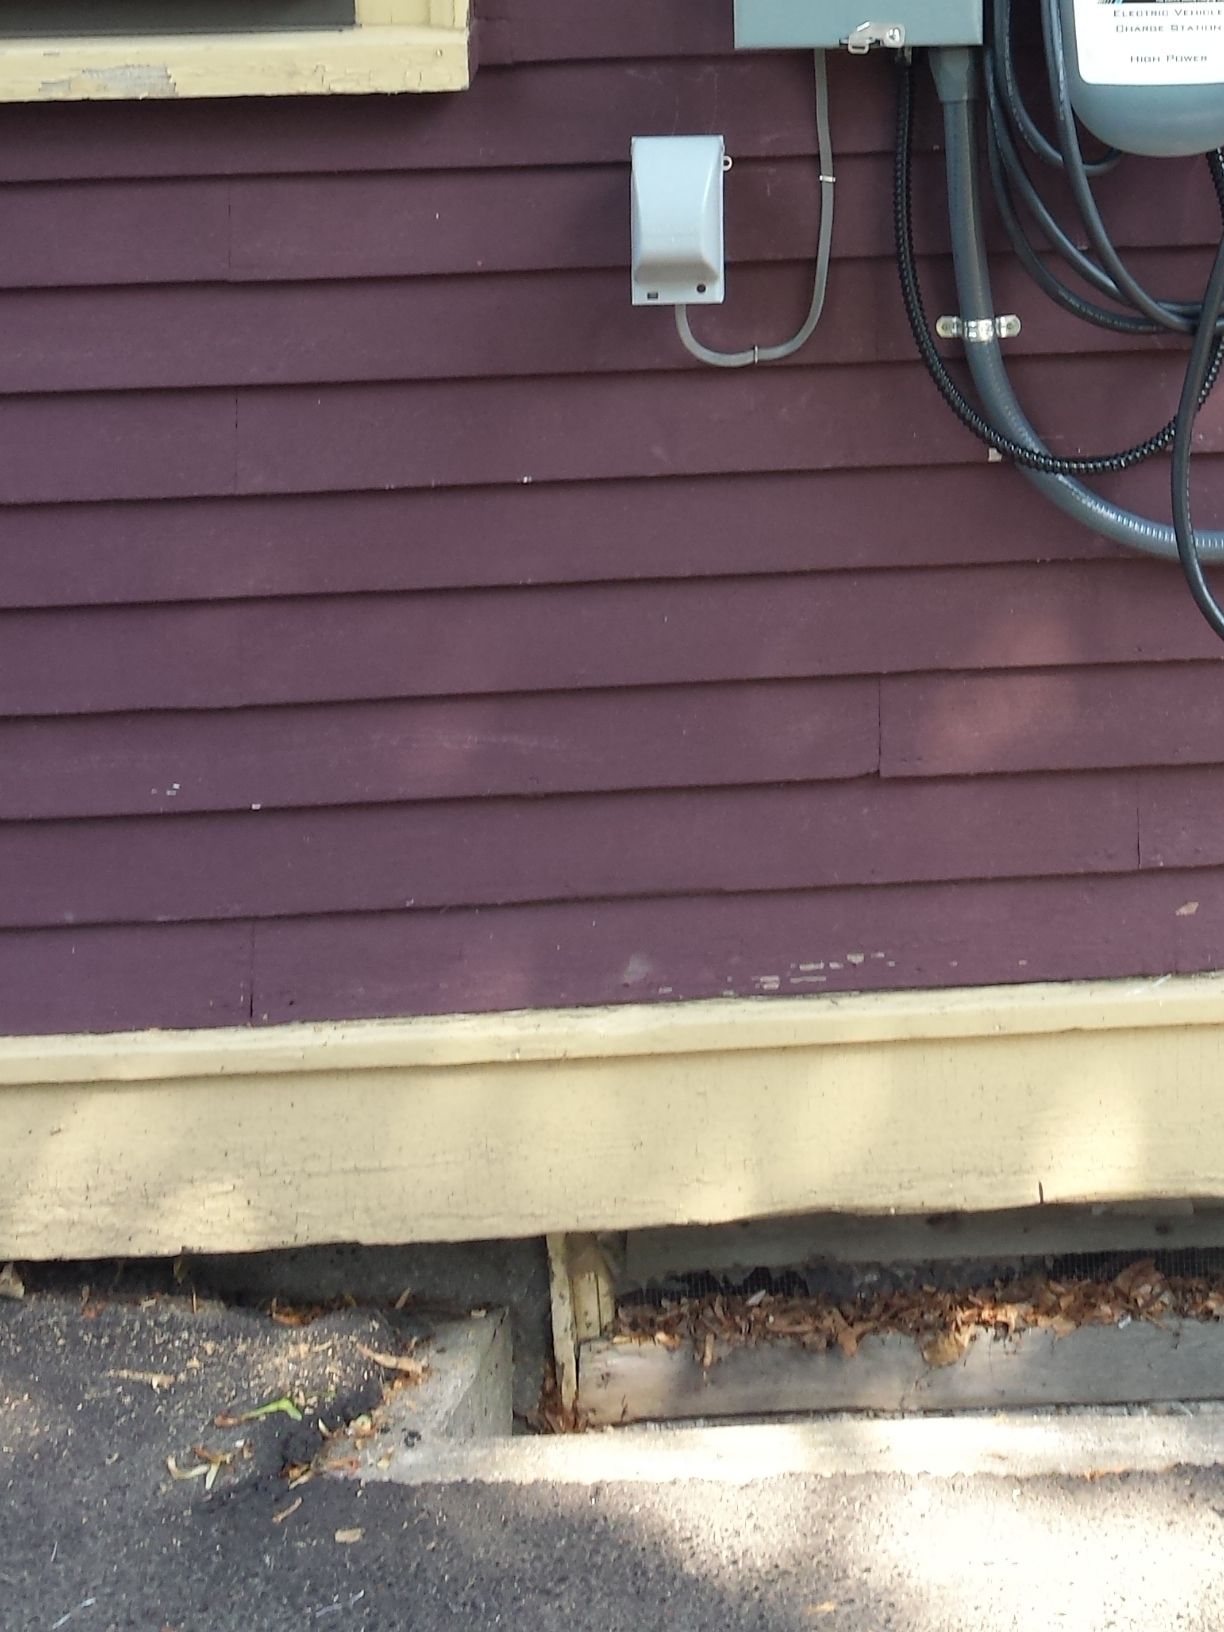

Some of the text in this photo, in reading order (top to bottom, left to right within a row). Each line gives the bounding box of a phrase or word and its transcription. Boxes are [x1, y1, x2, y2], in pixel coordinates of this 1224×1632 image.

[1113, 8, 1223, 18] ELECTRIC VEHICLE
[1115, 23, 1222, 33] CHARGE STATION
[1130, 54, 1208, 64] HIGH POWER
